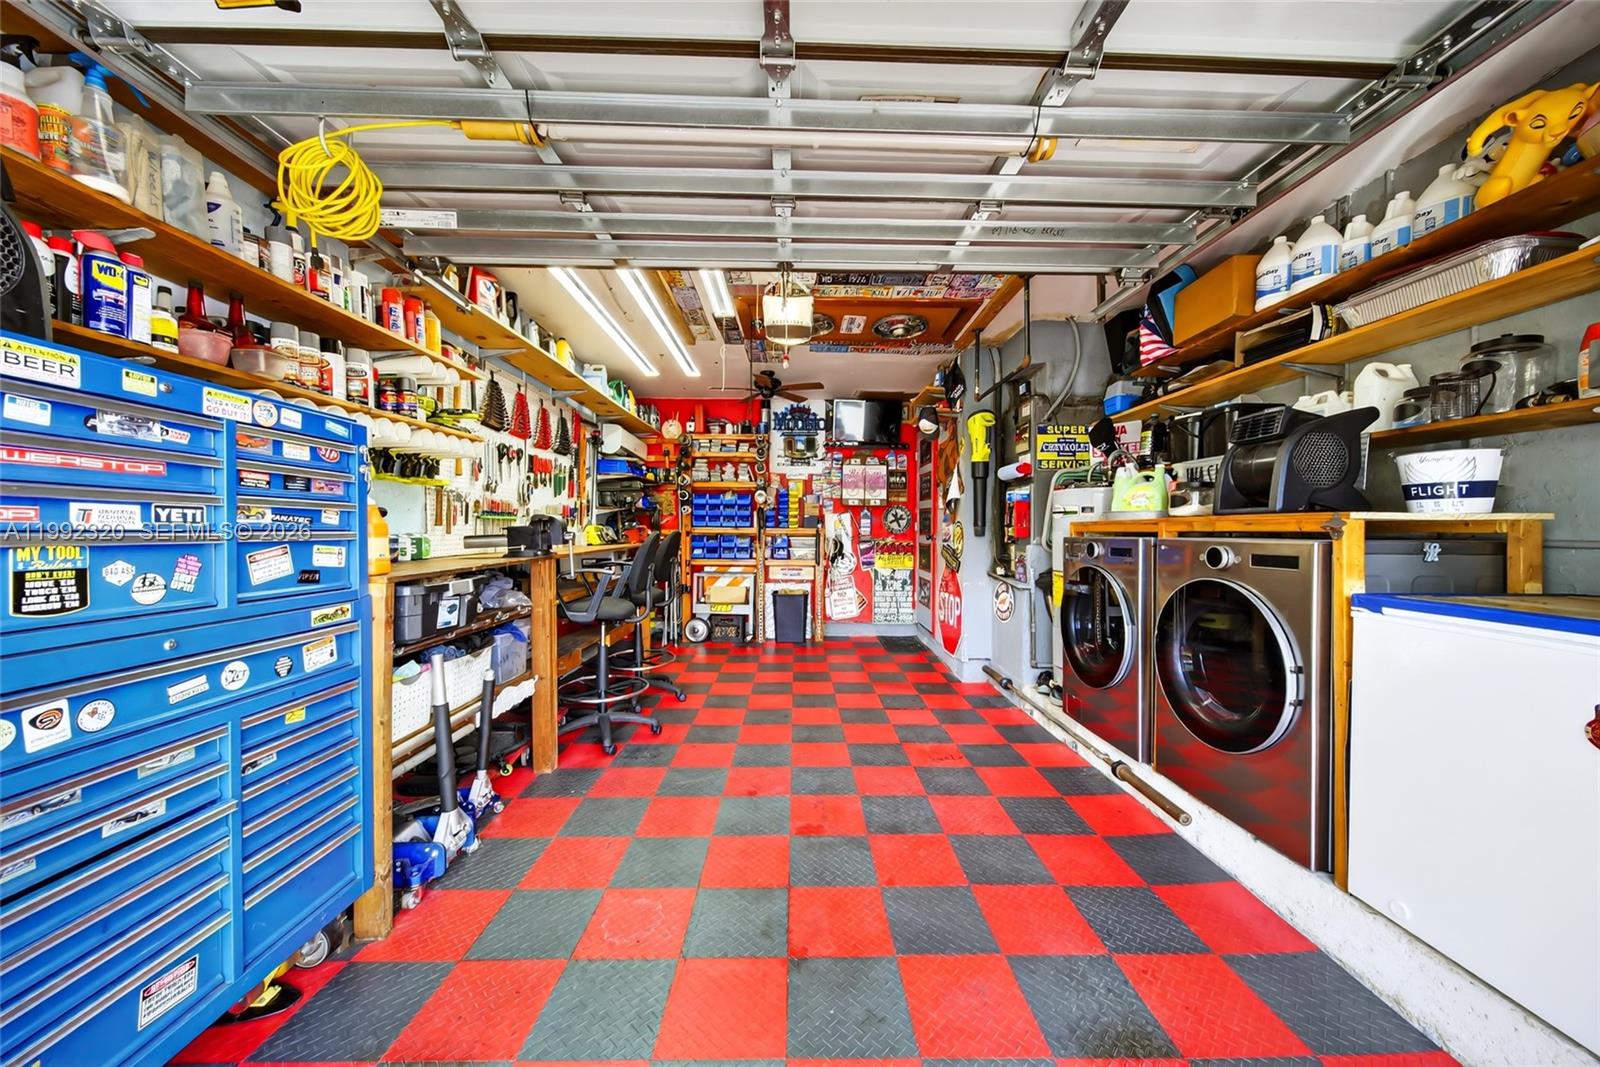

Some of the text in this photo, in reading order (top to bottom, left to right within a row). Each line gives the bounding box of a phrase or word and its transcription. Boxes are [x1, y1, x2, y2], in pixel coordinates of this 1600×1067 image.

[16, 344, 66, 361] ATTENTION
[4, 350, 75, 377] BEER
[1047, 425, 1086, 434] SUPER
[0, 448, 165, 475] WERSTOP
[1410, 483, 1469, 497] FLIGHT
[155, 506, 203, 523] YETI
[17, 545, 83, 562] MY TOOL
[939, 592, 961, 628] STOP
